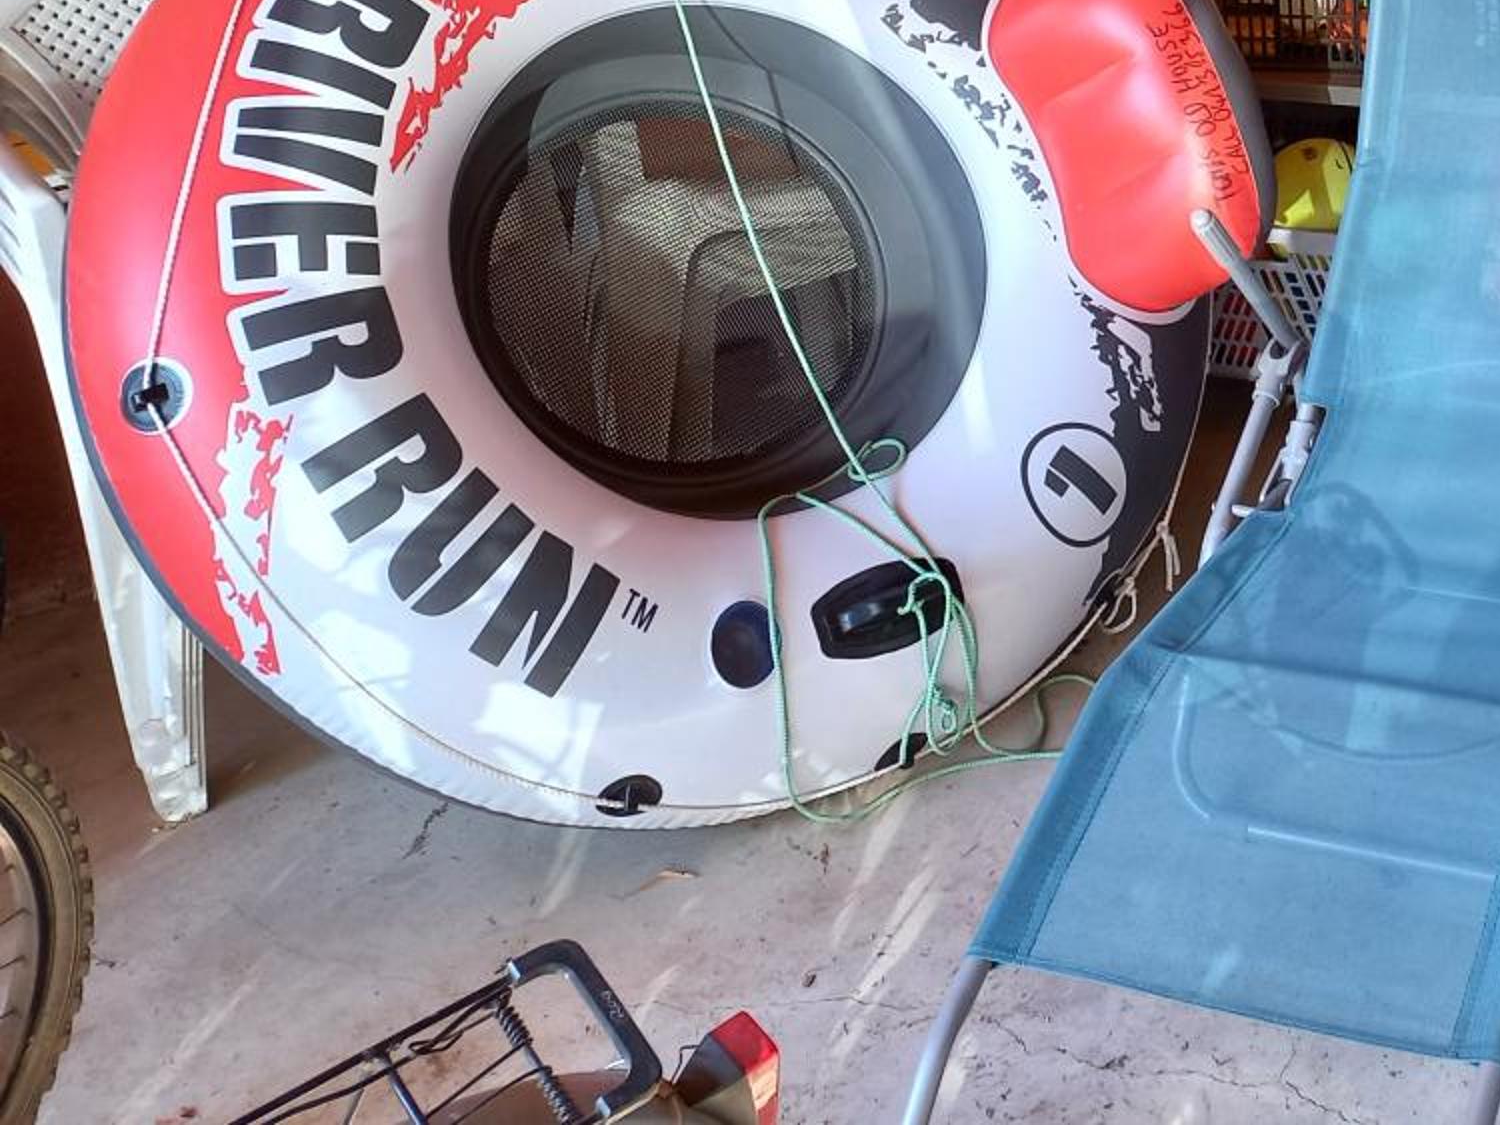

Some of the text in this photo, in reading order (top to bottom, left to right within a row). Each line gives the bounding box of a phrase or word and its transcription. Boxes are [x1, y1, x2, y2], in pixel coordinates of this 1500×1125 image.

[1147, 21, 1200, 94] HOUSE
[1184, 102, 1217, 137] OLD
[300, 392, 621, 698] RUN
